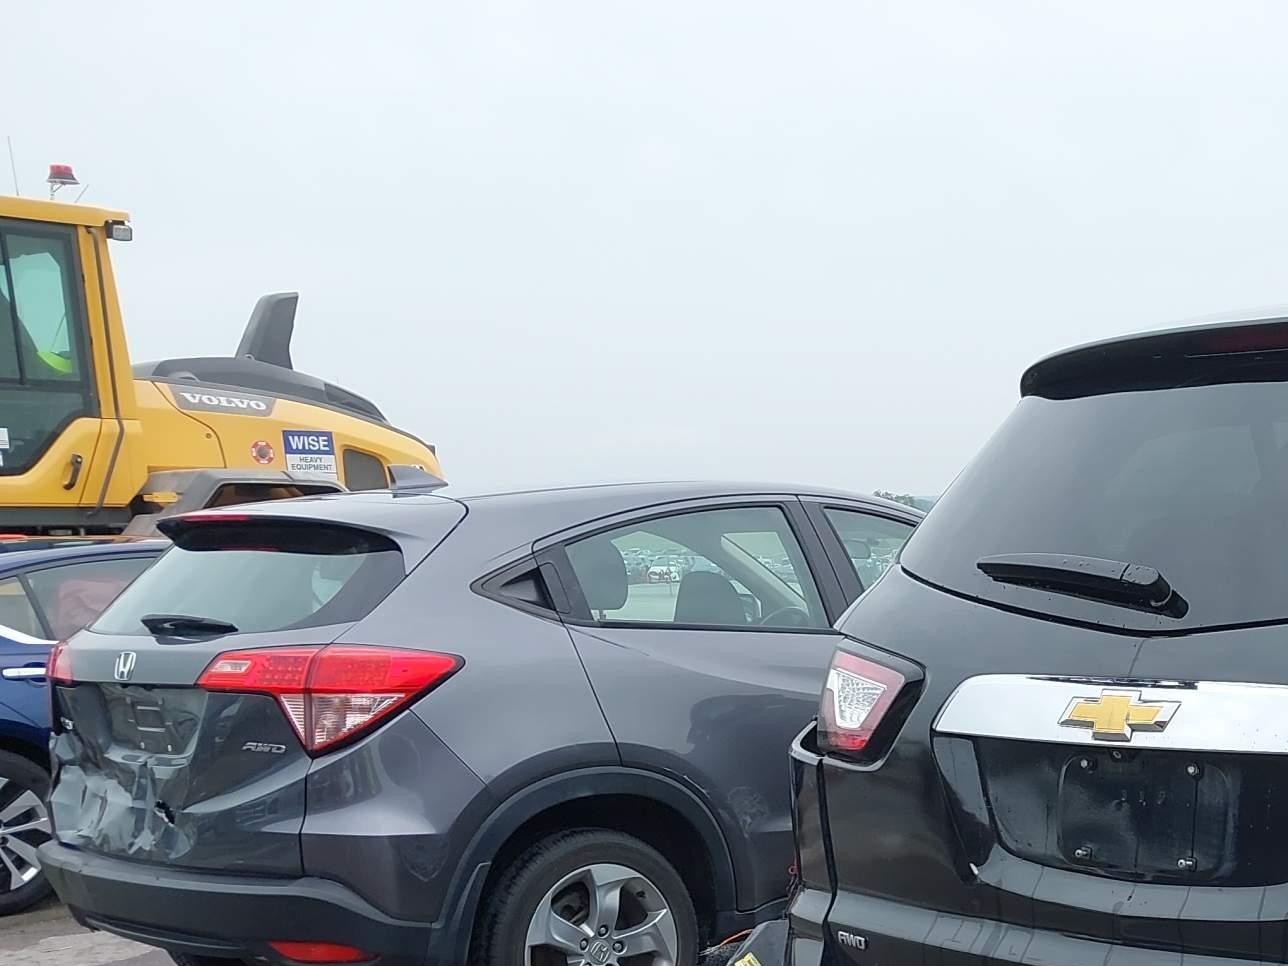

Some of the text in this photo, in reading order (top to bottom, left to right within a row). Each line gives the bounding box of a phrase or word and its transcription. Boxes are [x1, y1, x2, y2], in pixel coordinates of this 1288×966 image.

[180, 392, 267, 410] VOLVO
[288, 435, 330, 451] WISE
[241, 742, 286, 753] AWD
[838, 931, 865, 950] AWD
